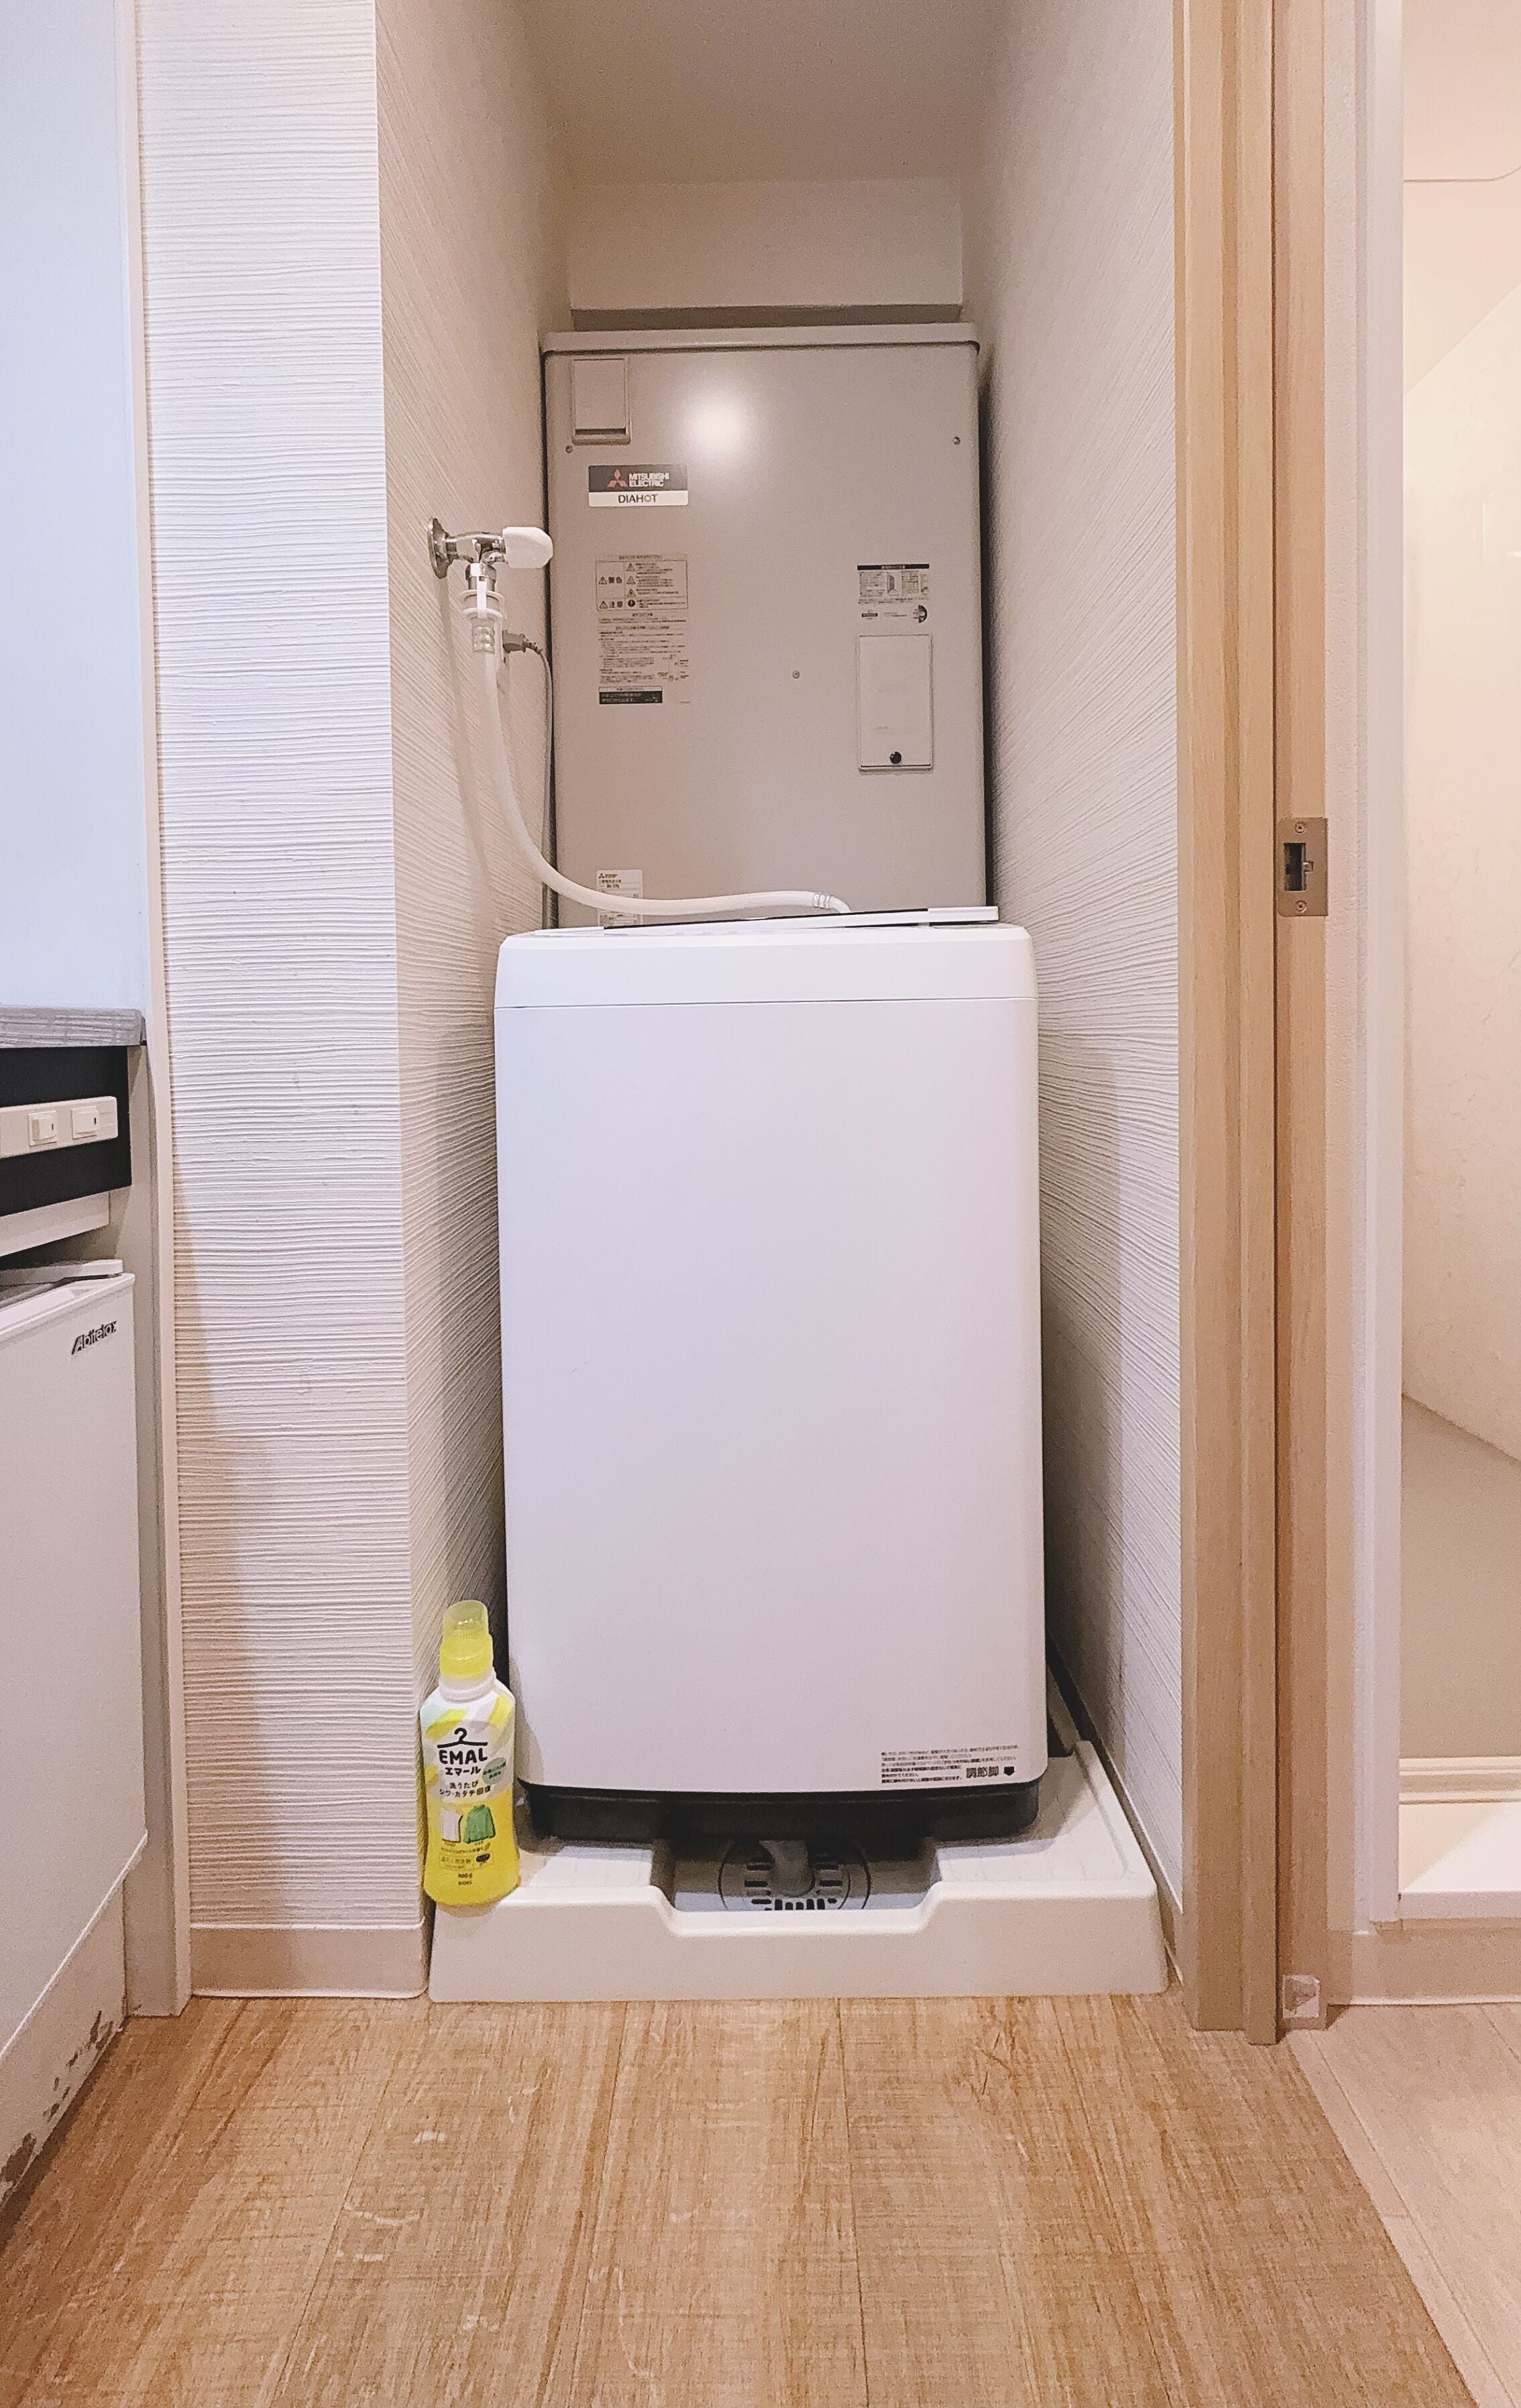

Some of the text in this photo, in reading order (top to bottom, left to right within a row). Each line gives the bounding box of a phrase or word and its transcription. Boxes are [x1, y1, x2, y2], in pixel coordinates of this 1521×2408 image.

[628, 472, 670, 481] MITSUBISHI
[618, 494, 658, 504] DIAHOT
[439, 1747, 488, 1765] EMAL
[445, 1766, 482, 1777] エマール
